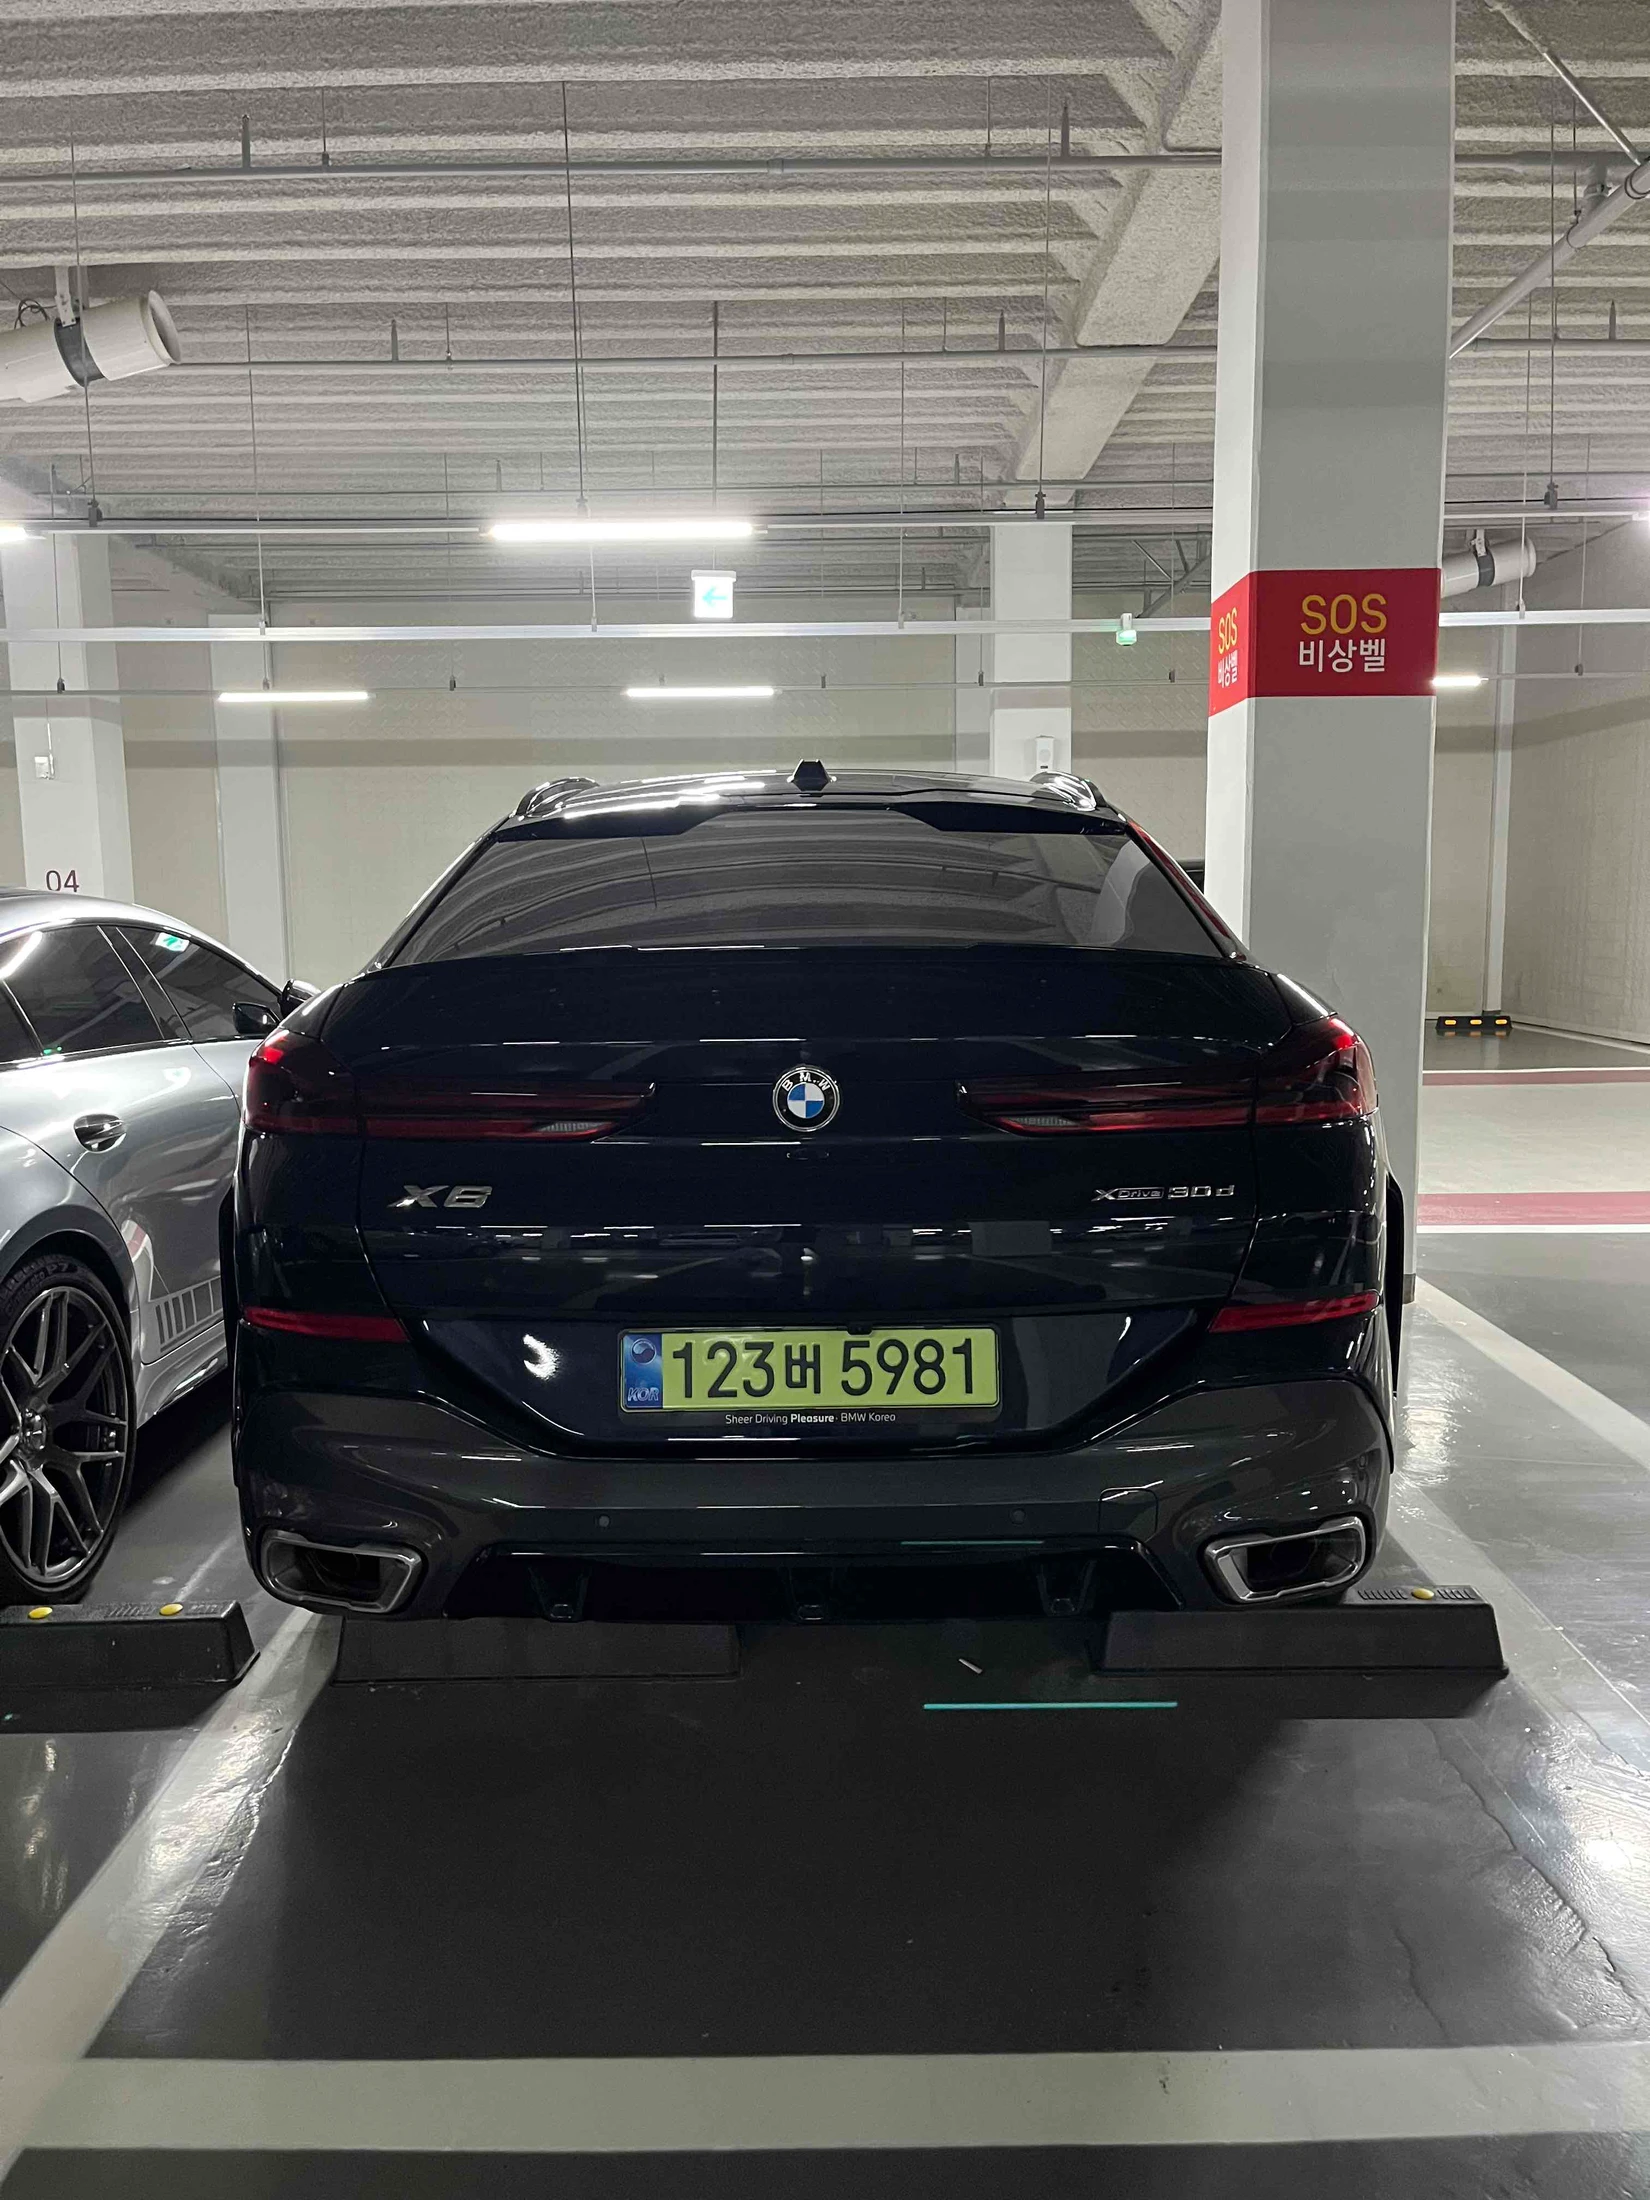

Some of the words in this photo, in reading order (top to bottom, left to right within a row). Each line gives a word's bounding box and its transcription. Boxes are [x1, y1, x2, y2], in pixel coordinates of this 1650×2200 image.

[1300, 593, 1388, 635] SOS
[1217, 607, 1238, 655] SOS
[1217, 650, 1239, 688] 비상벨
[1299, 638, 1387, 673] 비상벨
[45, 869, 80, 893] 04
[781, 1071, 831, 1092] BMW
[386, 1185, 493, 1208] X6
[672, 1340, 822, 1399] 123버
[840, 1337, 975, 1396] 5981
[627, 1387, 660, 1402] KOR
[725, 1414, 753, 1425] Sheer
[755, 1413, 788, 1426] Driving
[790, 1413, 835, 1424] Pleasure
[840, 1412, 867, 1423] BMW
[868, 1412, 897, 1423] Korea
